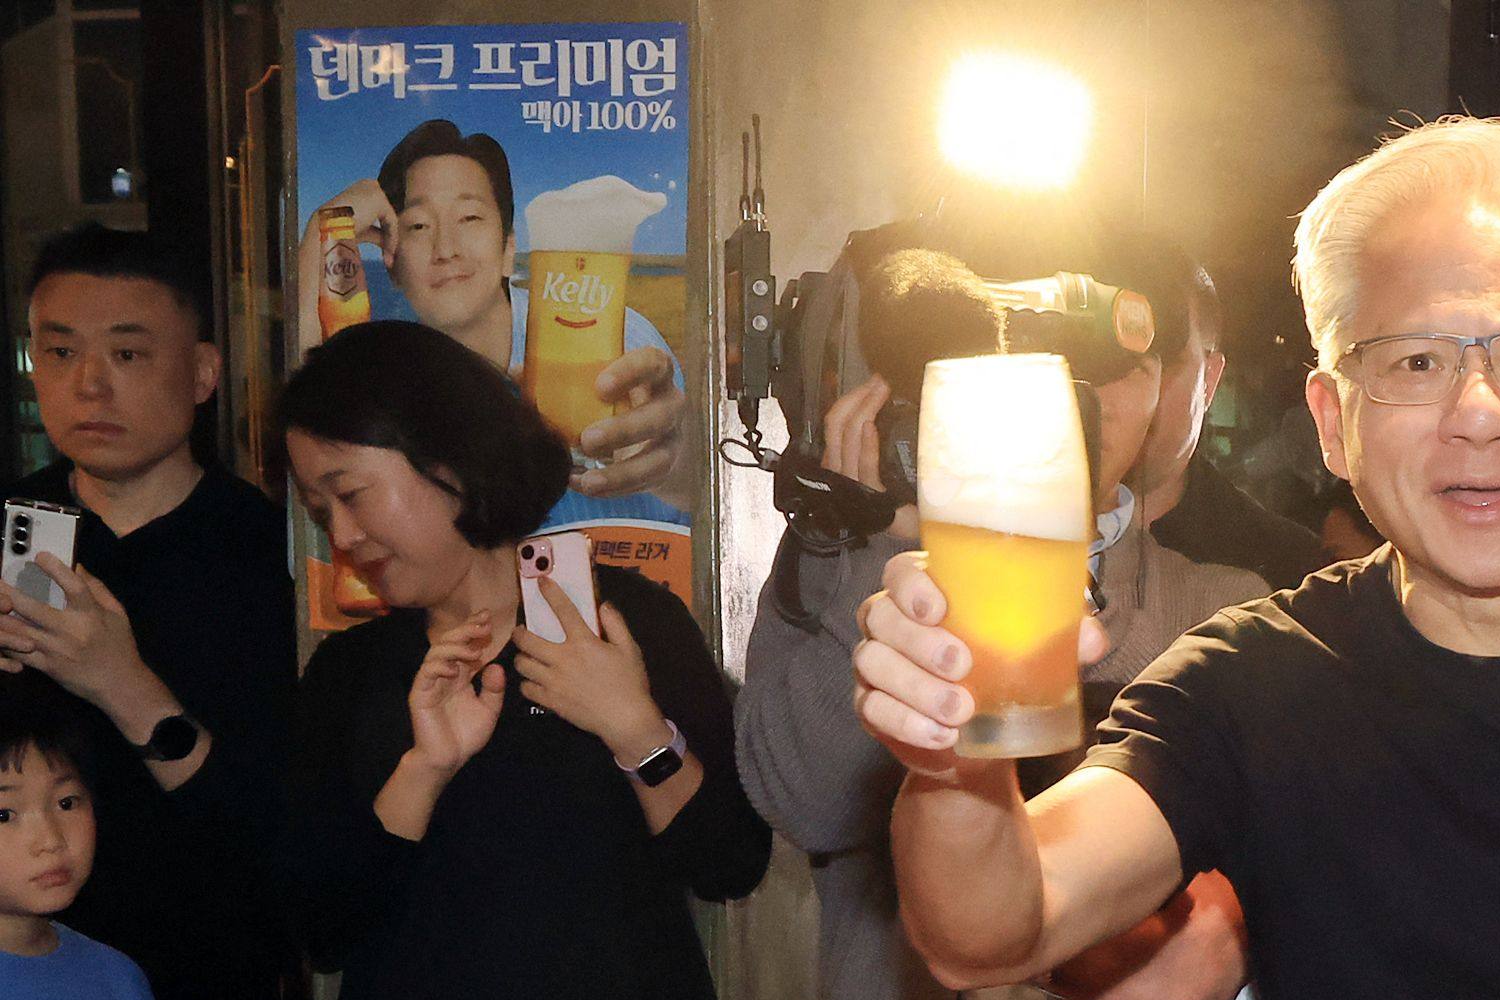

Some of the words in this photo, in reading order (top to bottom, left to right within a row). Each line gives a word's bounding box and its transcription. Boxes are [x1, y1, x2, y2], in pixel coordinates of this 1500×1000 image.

[308, 42, 457, 99] 덴마크
[468, 38, 677, 97] 프리미엄
[521, 101, 583, 134] 맥아
[586, 100, 676, 131] 100%
[542, 271, 615, 315] Kelly
[635, 542, 670, 560] 라거
